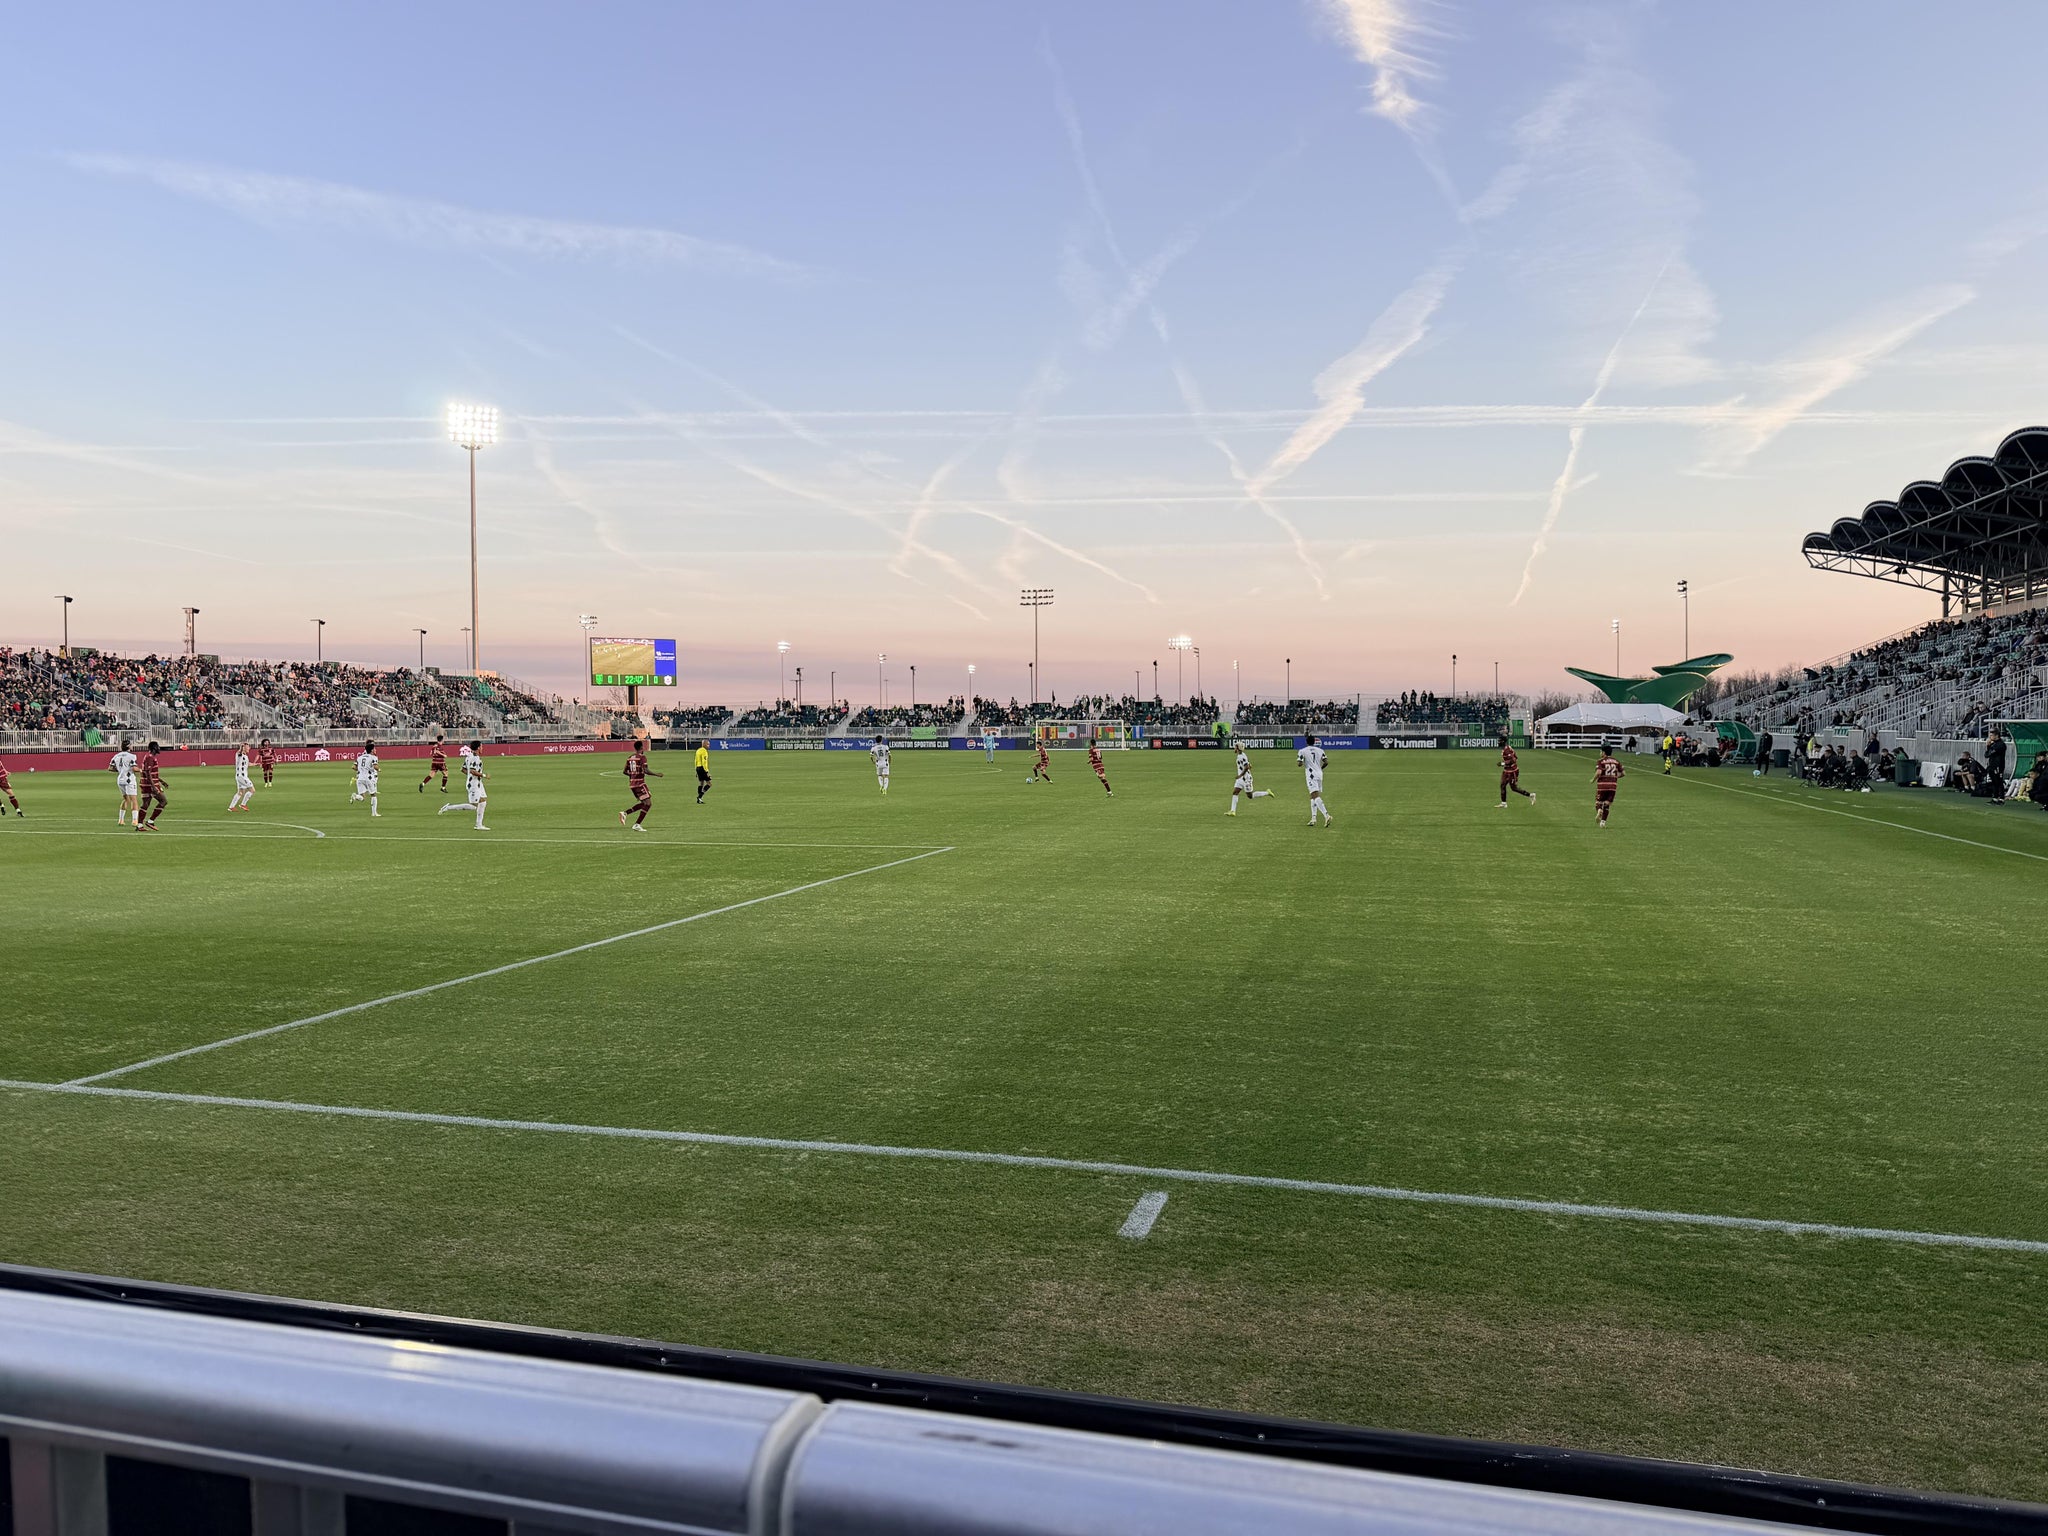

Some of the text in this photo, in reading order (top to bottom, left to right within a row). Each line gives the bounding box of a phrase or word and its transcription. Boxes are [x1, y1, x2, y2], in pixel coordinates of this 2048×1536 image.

[608, 675, 612, 684] 0
[625, 675, 644, 684] 22:47
[654, 676, 658, 684] 0
[1394, 738, 1437, 748] hummel
[568, 744, 594, 752] appalachia
[284, 752, 310, 762] health
[336, 752, 354, 760] more
[1311, 752, 1316, 763] 7
[1605, 764, 1616, 776] 22
